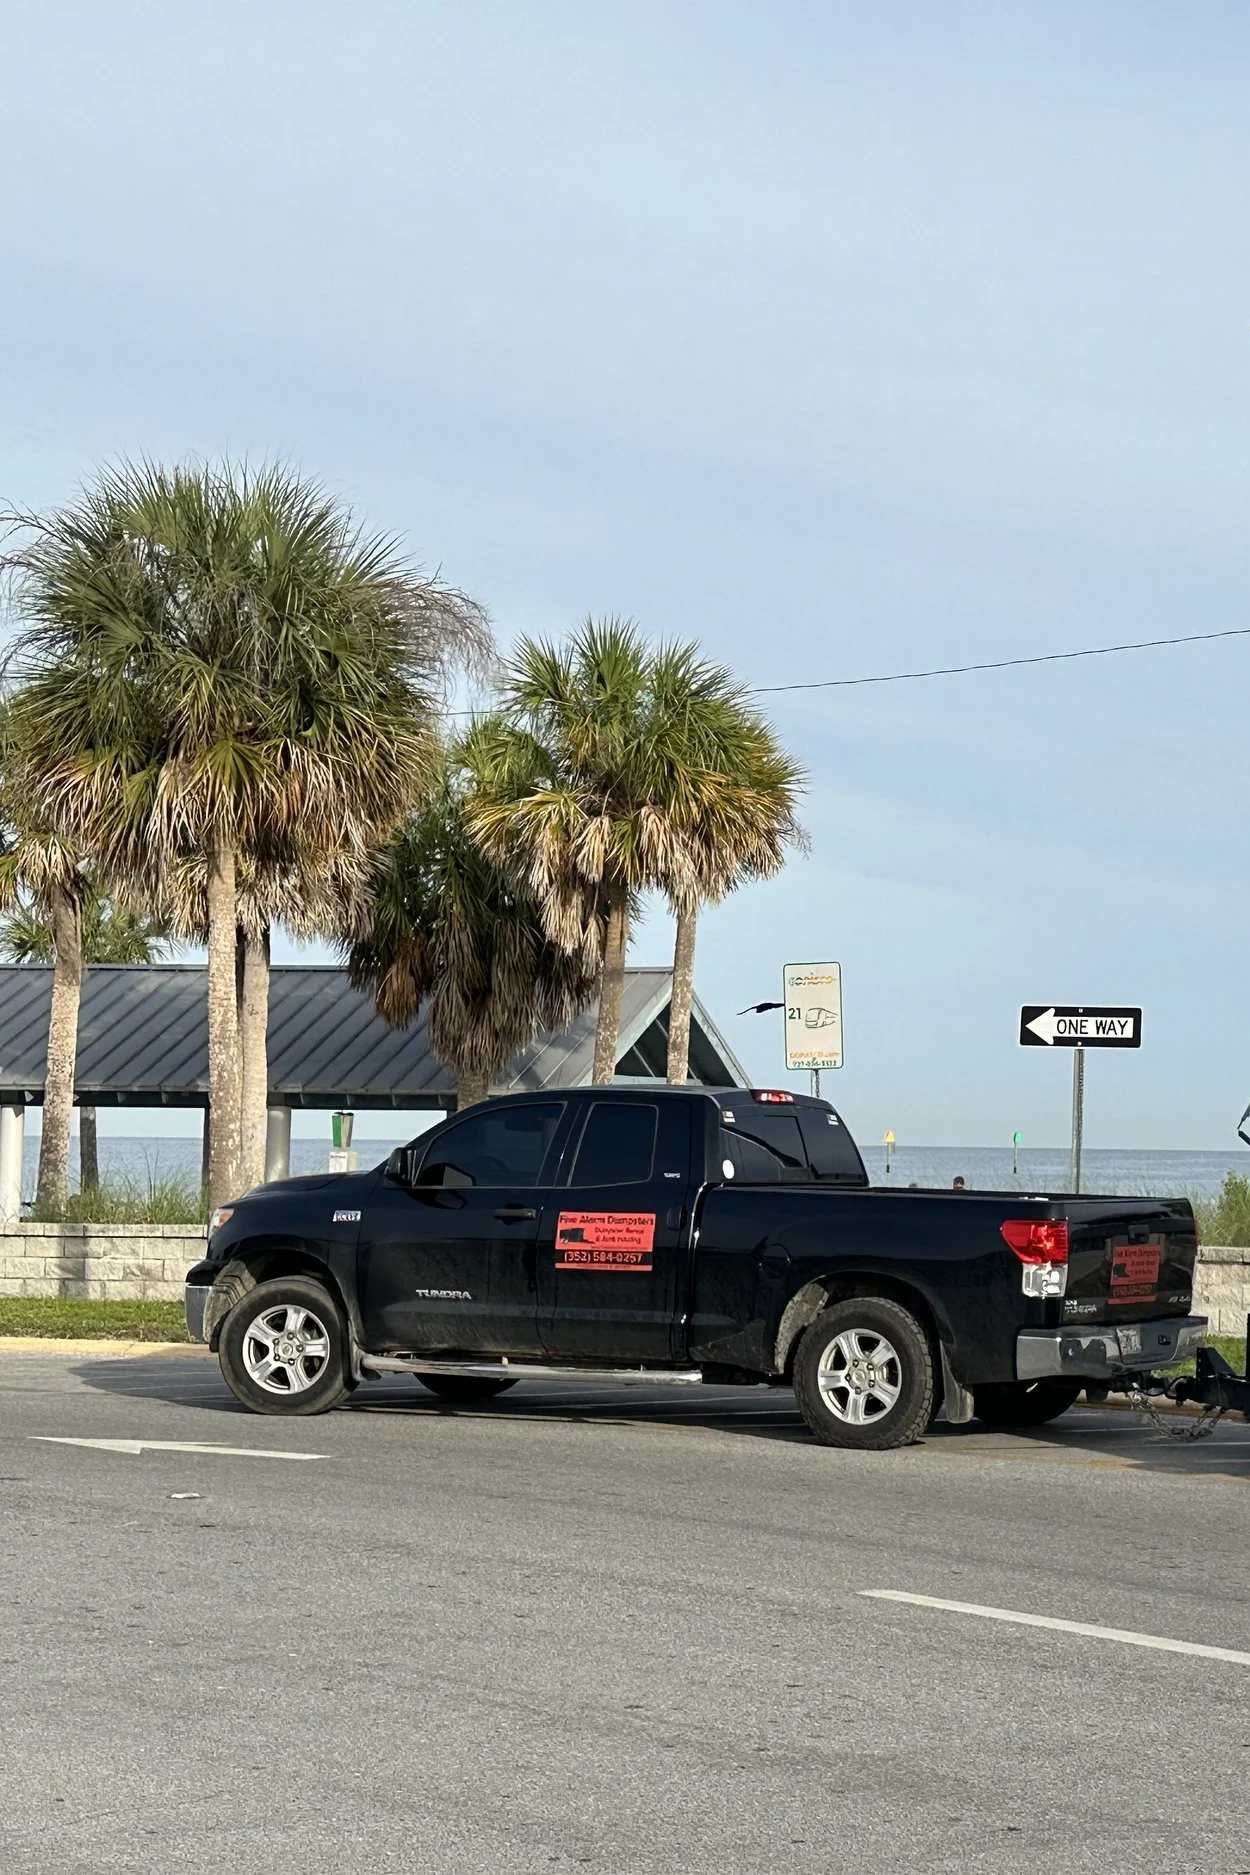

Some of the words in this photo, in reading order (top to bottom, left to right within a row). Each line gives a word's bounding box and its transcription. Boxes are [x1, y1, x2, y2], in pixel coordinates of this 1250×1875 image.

[788, 1008, 801, 1019] 21
[1057, 1019, 1088, 1034] ONE
[1095, 1019, 1128, 1035] WAY
[560, 1215, 577, 1223] Five
[580, 1215, 605, 1224] Alarm
[608, 1216, 653, 1225] Dumpsters
[564, 1252, 591, 1263] (352)
[415, 1289, 472, 1299] TUNDRA
